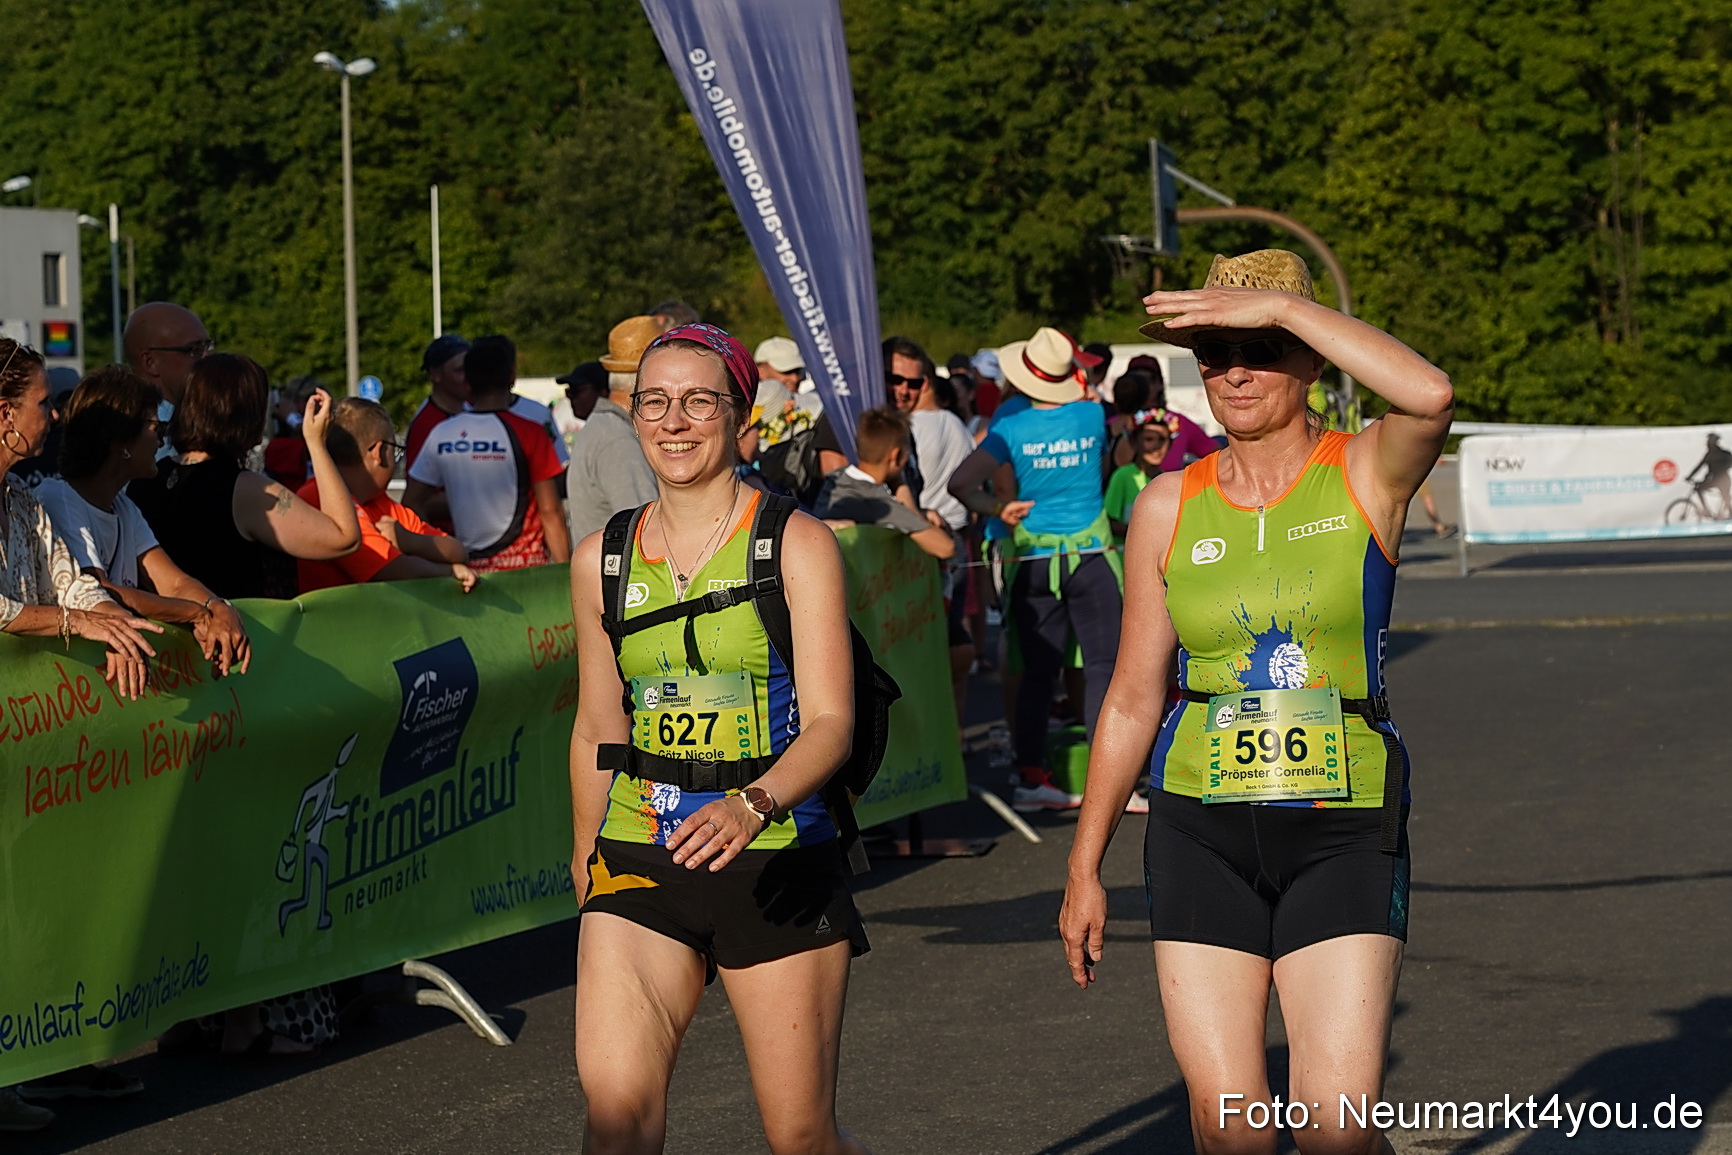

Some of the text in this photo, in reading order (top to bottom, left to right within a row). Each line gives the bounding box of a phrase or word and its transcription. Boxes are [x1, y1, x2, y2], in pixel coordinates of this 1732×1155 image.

[1288, 514, 1348, 541] BOCK
[412, 687, 469, 723] Fischer
[659, 694, 692, 704] Firmenlauf
[1235, 708, 1278, 722] Firmenlauf
[643, 716, 651, 749] ALK
[658, 711, 720, 747] 627
[736, 713, 752, 759] 2022
[1250, 716, 1278, 725] neumarkt
[25, 686, 247, 818] laufen länger!
[685, 748, 725, 760] Nicole
[1210, 736, 1221, 789] WALK
[1234, 726, 1308, 765] 596
[1324, 731, 1339, 782] 2022
[1220, 765, 1326, 781] Pröpster Cornelia
[345, 725, 524, 880] firmenlauf
[345, 853, 428, 915] neumarkt
[470, 860, 574, 916] www.firmenla
[0, 940, 210, 1053] enlauf-oberpfalz.de
